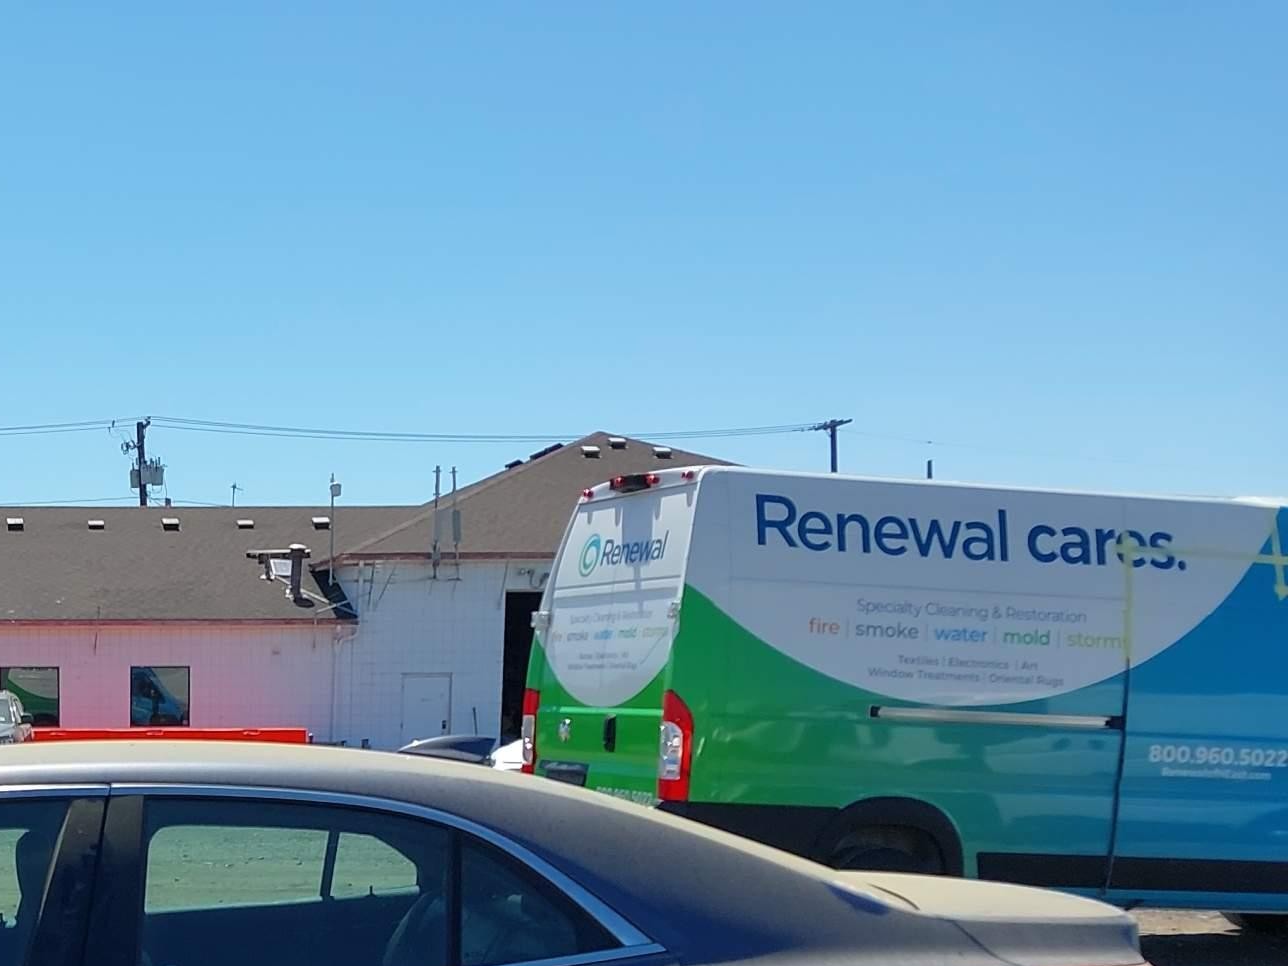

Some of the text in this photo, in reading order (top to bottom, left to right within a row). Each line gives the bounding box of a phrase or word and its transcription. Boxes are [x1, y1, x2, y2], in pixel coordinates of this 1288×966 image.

[755, 493, 1187, 571] Renewal cares.
[600, 530, 669, 567] Renewal
[857, 599, 1087, 623] Specialty Cleaning & Restoration
[809, 617, 1122, 648] fire smoke water mold storm
[898, 654, 939, 667] Textiles
[867, 666, 915, 680] Window
[918, 669, 980, 684] Treatments
[1149, 744, 1288, 767] 800.960.5022
